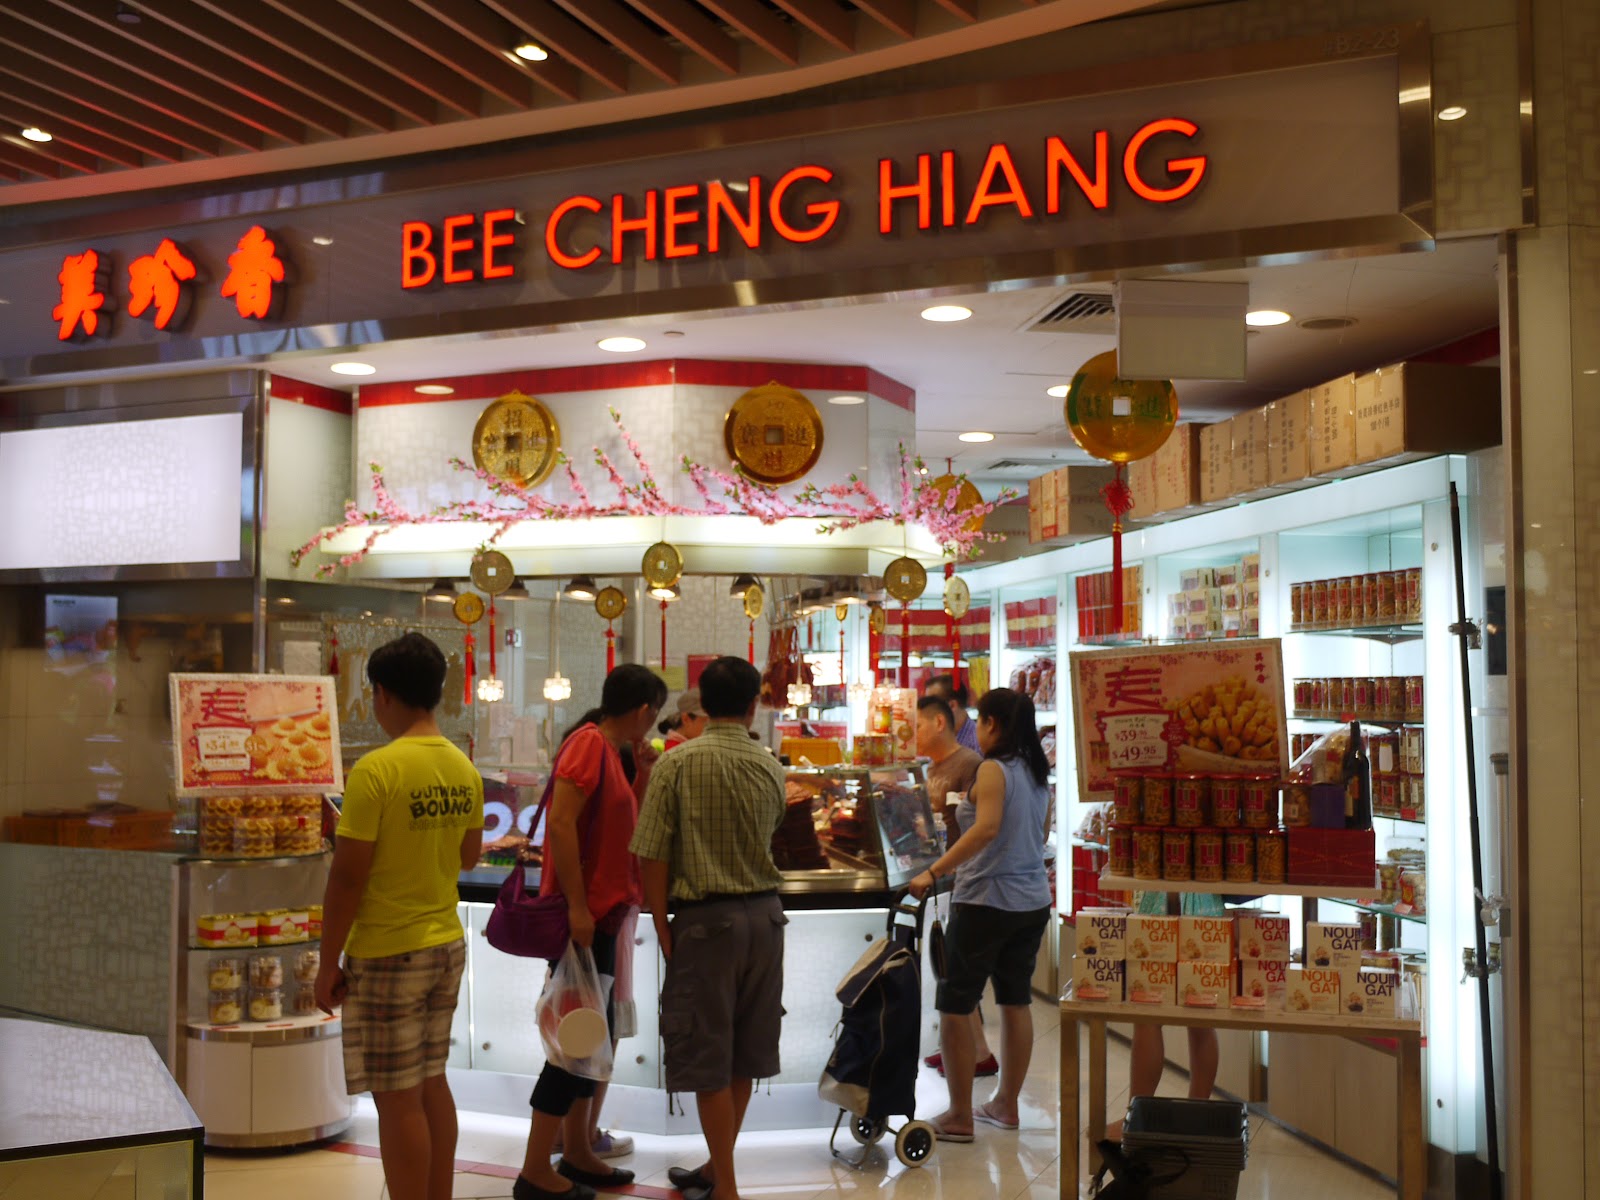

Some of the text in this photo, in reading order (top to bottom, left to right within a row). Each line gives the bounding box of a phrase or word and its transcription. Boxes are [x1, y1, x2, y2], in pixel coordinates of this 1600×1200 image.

[1322, 29, 1399, 56] #B2-23
[401, 119, 1206, 289] BEE CHENG HIANG
[52, 225, 285, 340] 美珍香
[409, 798, 473, 819] BOUND
[1098, 928, 1126, 939] GAT
[1149, 931, 1176, 942] GAT
[1201, 932, 1229, 943] GAT
[1262, 930, 1289, 942] GAT
[1331, 939, 1361, 950] GAT
[1094, 971, 1122, 982] GAT
[1148, 973, 1176, 984] GAT
[1200, 976, 1229, 987] GAT
[1266, 971, 1286, 983] GA
[1309, 982, 1339, 994] GAT
[1365, 984, 1394, 996] GAT
